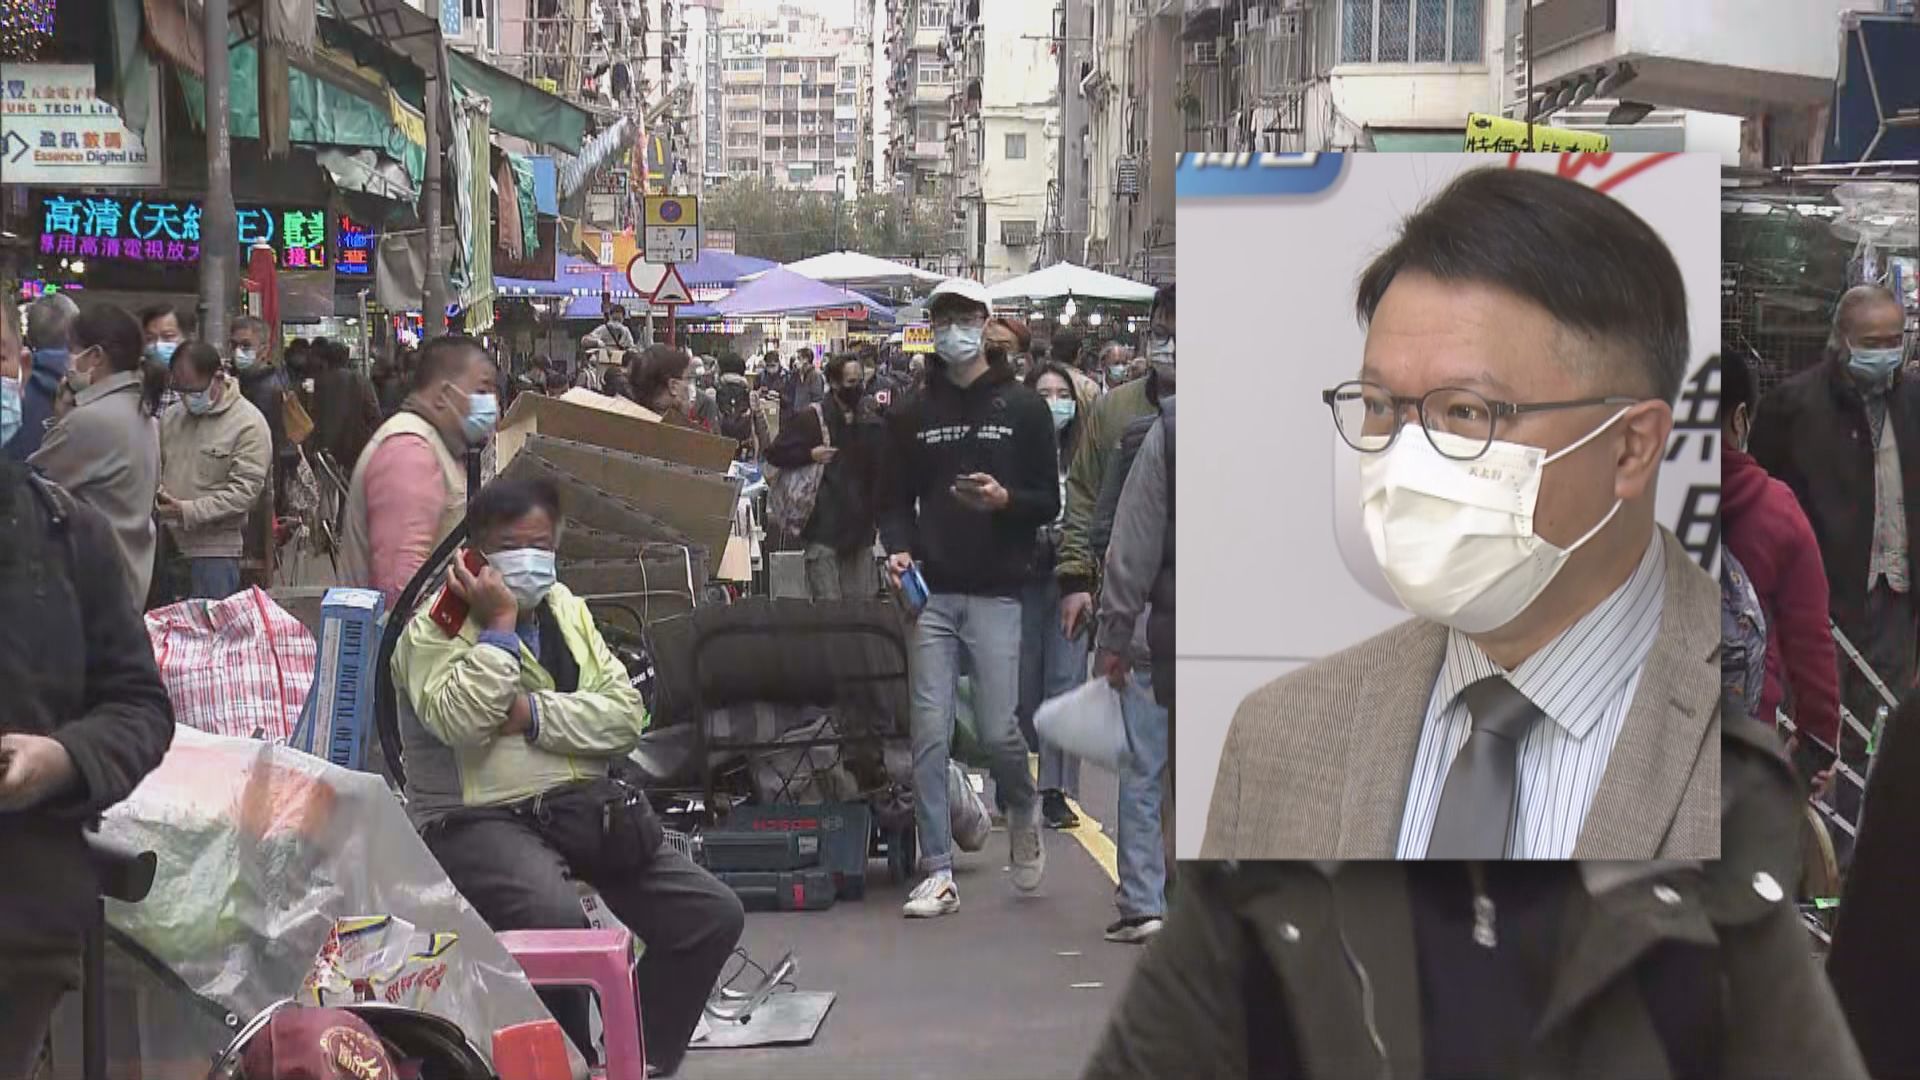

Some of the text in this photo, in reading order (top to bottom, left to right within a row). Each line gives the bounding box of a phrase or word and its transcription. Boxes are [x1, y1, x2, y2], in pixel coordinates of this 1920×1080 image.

[44, 103, 82, 114] TECH
[34, 150, 148, 166] Essence Digital Ltd
[677, 228, 687, 241] 7
[337, 664, 359, 721] DIGITAL
